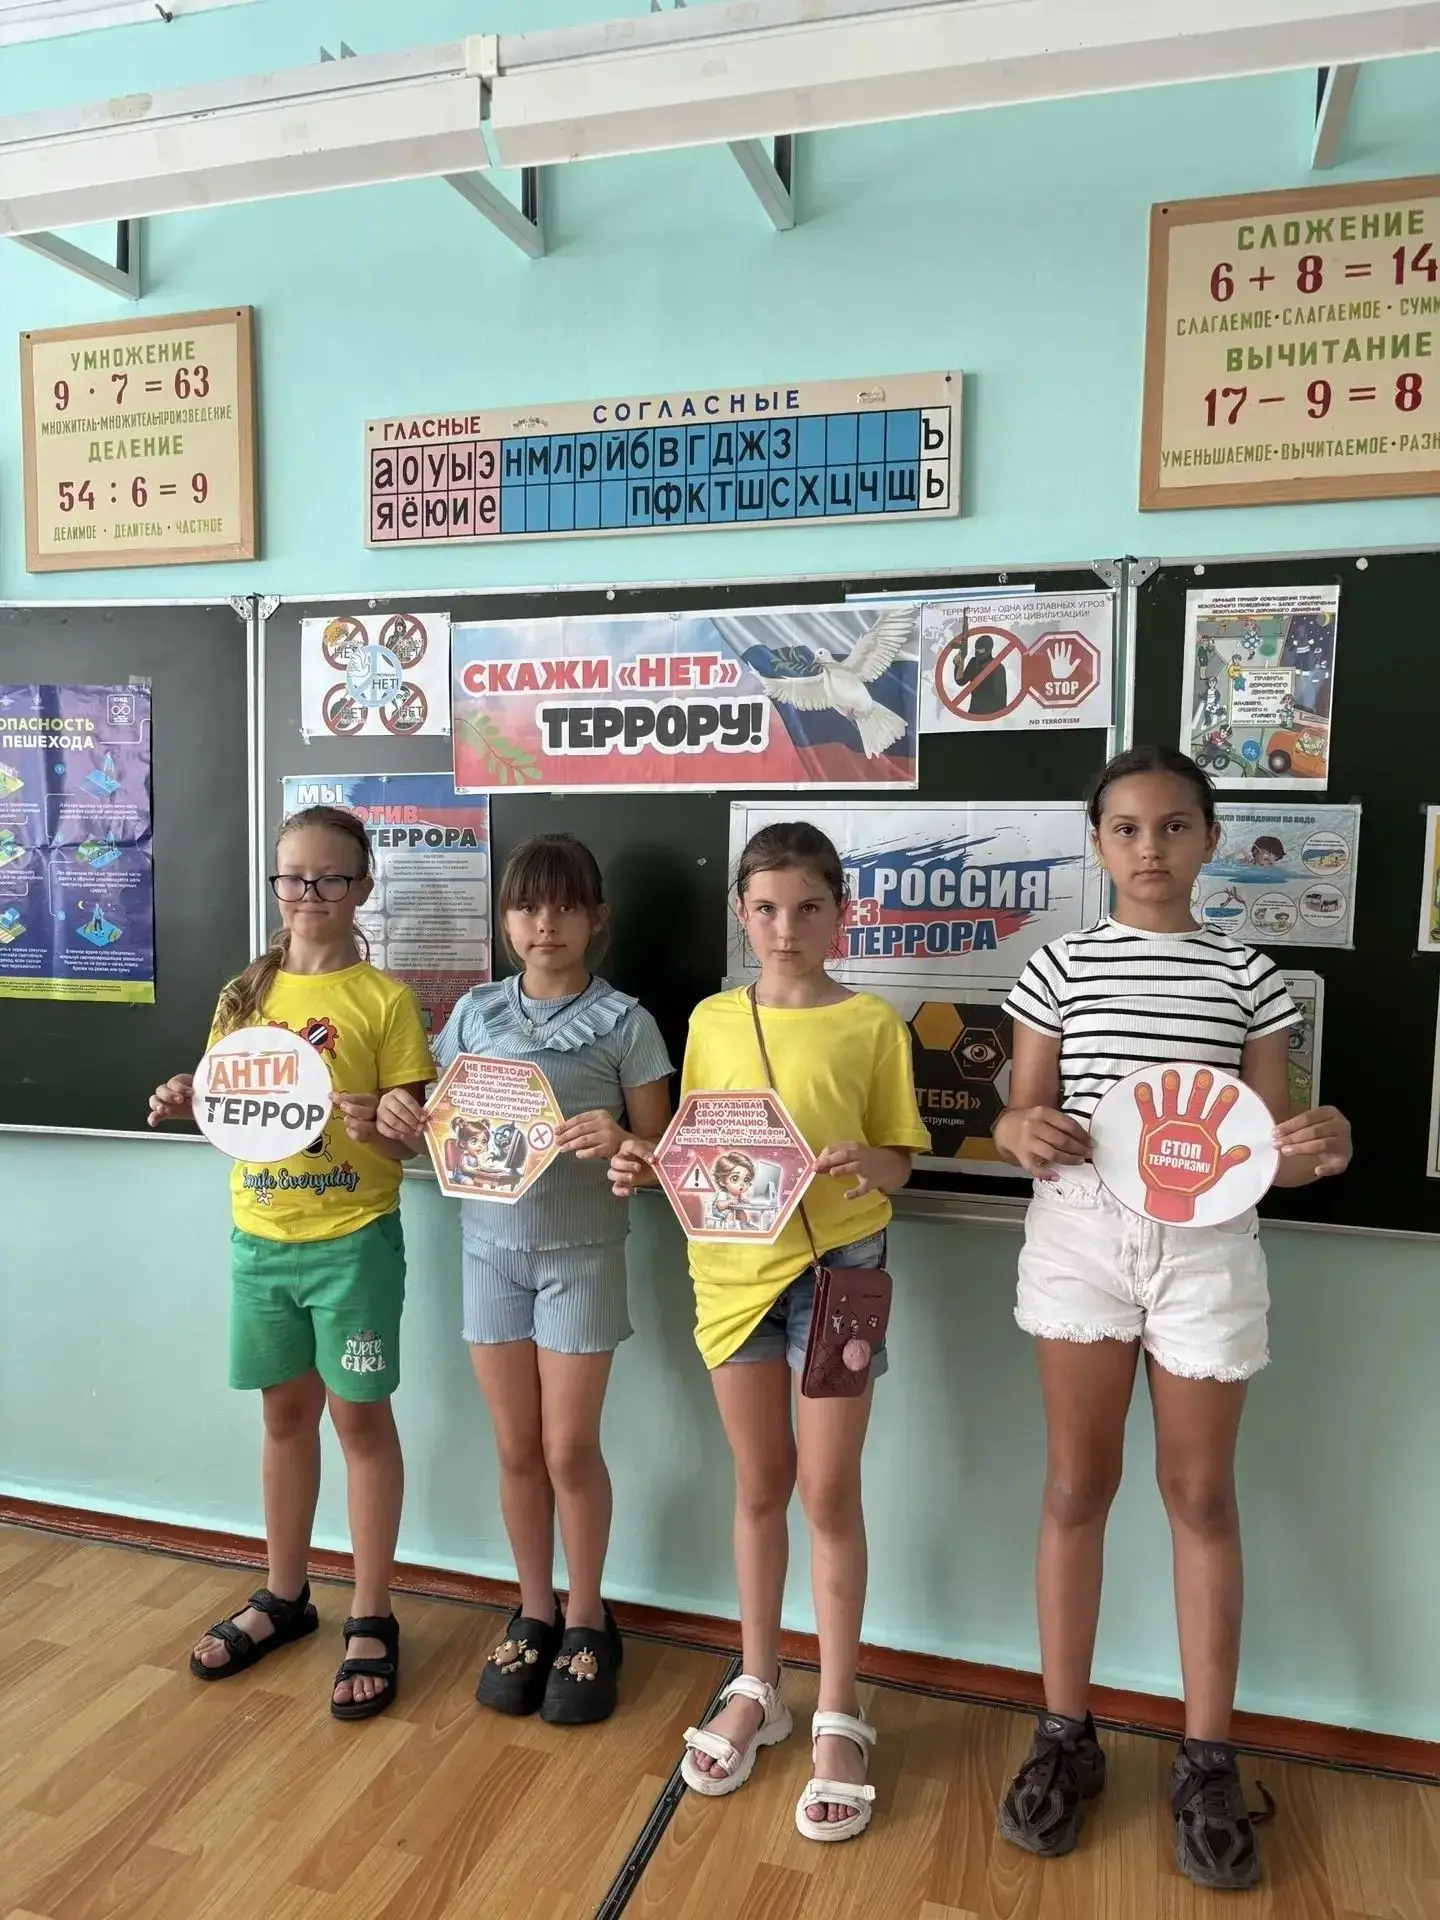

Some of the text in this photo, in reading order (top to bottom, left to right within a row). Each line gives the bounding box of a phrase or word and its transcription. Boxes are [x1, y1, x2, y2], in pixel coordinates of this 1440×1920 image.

[1237, 209, 1424, 251] СЛОЖЕНИЕ
[1210, 262, 1234, 302] 6
[1296, 255, 1323, 294] 8
[1392, 243, 1440, 285] 14
[71, 341, 195, 371] УМНОЖЕНИЕ
[1226, 331, 1432, 372] ВЫЧИТАНИЕ
[53, 380, 70, 411] 9
[111, 374, 128, 404] 7
[174, 365, 210, 399] 63
[1204, 386, 1248, 427] 17
[1306, 379, 1331, 419] 9
[1395, 373, 1422, 412] 8
[383, 390, 799, 441] ГЛАСНЫЕ СОГЛАСНЫЕ
[88, 435, 184, 463] ДЕЛЕНИЕ
[58, 480, 95, 512] 54
[131, 476, 148, 507] 6
[191, 472, 208, 503] 9
[54, 518, 223, 542] ДЕЛИМОЕ ДЕЛИТЕЛЬ ЧАСТНОЕ
[998, 605, 1022, 613] ОДНА
[1023, 604, 1034, 612] ИЗ
[1036, 602, 1075, 611] ГЛАВНЫХ
[1078, 600, 1105, 609] УГРОЗ
[372, 678, 399, 690] НЕТ!
[463, 655, 738, 693] СКАЖИ «НЕТ»
[1045, 681, 1079, 696] STOP
[541, 702, 763, 749] ТЕРРОРУ!
[1041, 717, 1080, 725] TERRORISM
[3, 736, 95, 751] ПЕШЕХОДА
[297, 784, 344, 805] МЫ
[874, 868, 1046, 909] РОССИЯ
[845, 898, 881, 926] ЕЗ
[847, 920, 997, 956] ТЕРРОРА
[211, 1056, 294, 1090] АНТИ
[466, 1063, 530, 1077] НЕ ПЕРЕХОДИ
[712, 1102, 763, 1110] УКАЗЫВАЙ
[914, 1088, 982, 1110] ТЕБЯ»
[205, 1096, 325, 1131] ТЕРРОР
[697, 1119, 767, 1127] ИНФОРМАЦИЮ:
[921, 1116, 965, 1126] струкции
[1149, 1153, 1211, 1174] ТЕРРОРИЗМУ
[1161, 1139, 1202, 1160] СТОП
[278, 1166, 359, 1195] Everyday
[346, 1339, 382, 1355] SUPER
[341, 1354, 386, 1373] GIRL
